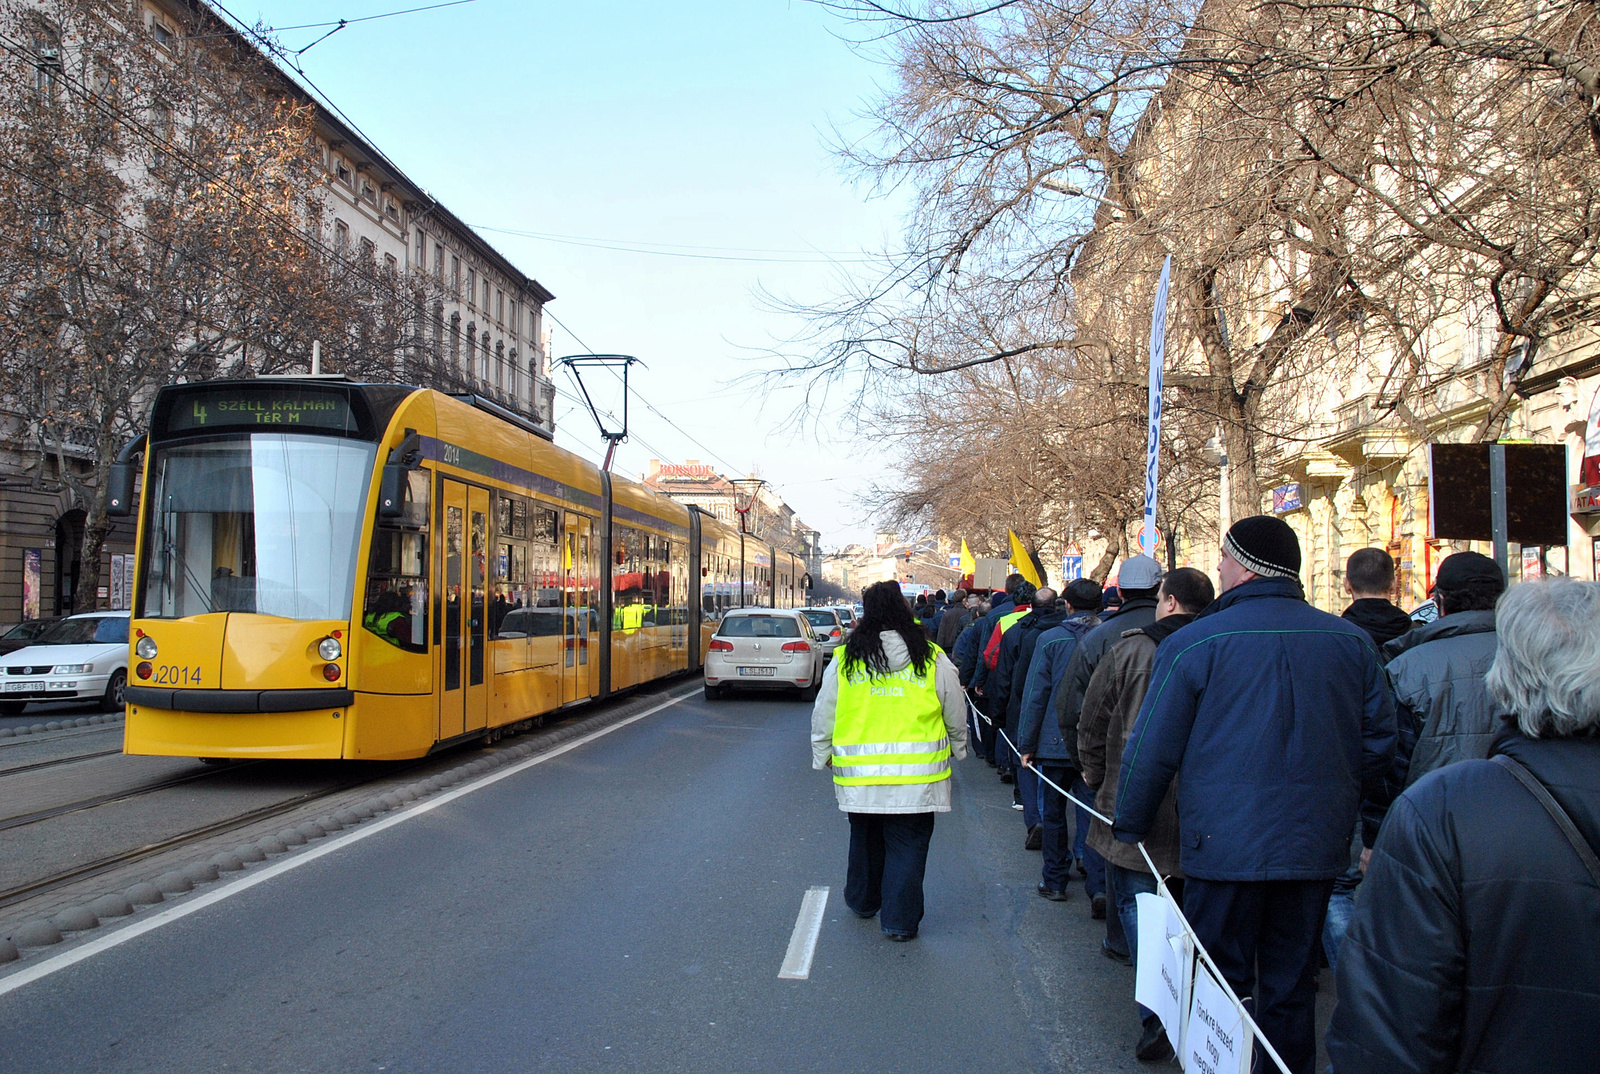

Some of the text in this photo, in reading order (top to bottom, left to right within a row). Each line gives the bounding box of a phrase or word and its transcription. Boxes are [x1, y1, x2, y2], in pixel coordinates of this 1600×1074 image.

[193, 400, 208, 424] 4
[217, 399, 336, 411] SZÉLL KÁLMÁN
[255, 412, 301, 423] TÉR M
[443, 444, 460, 465] 2014
[660, 464, 709, 477] BORSODI
[158, 665, 201, 685] 2014
[870, 687, 904, 697] POLICE
[1196, 998, 1216, 1031] Tönkre
[1206, 1035, 1220, 1066] hogy
